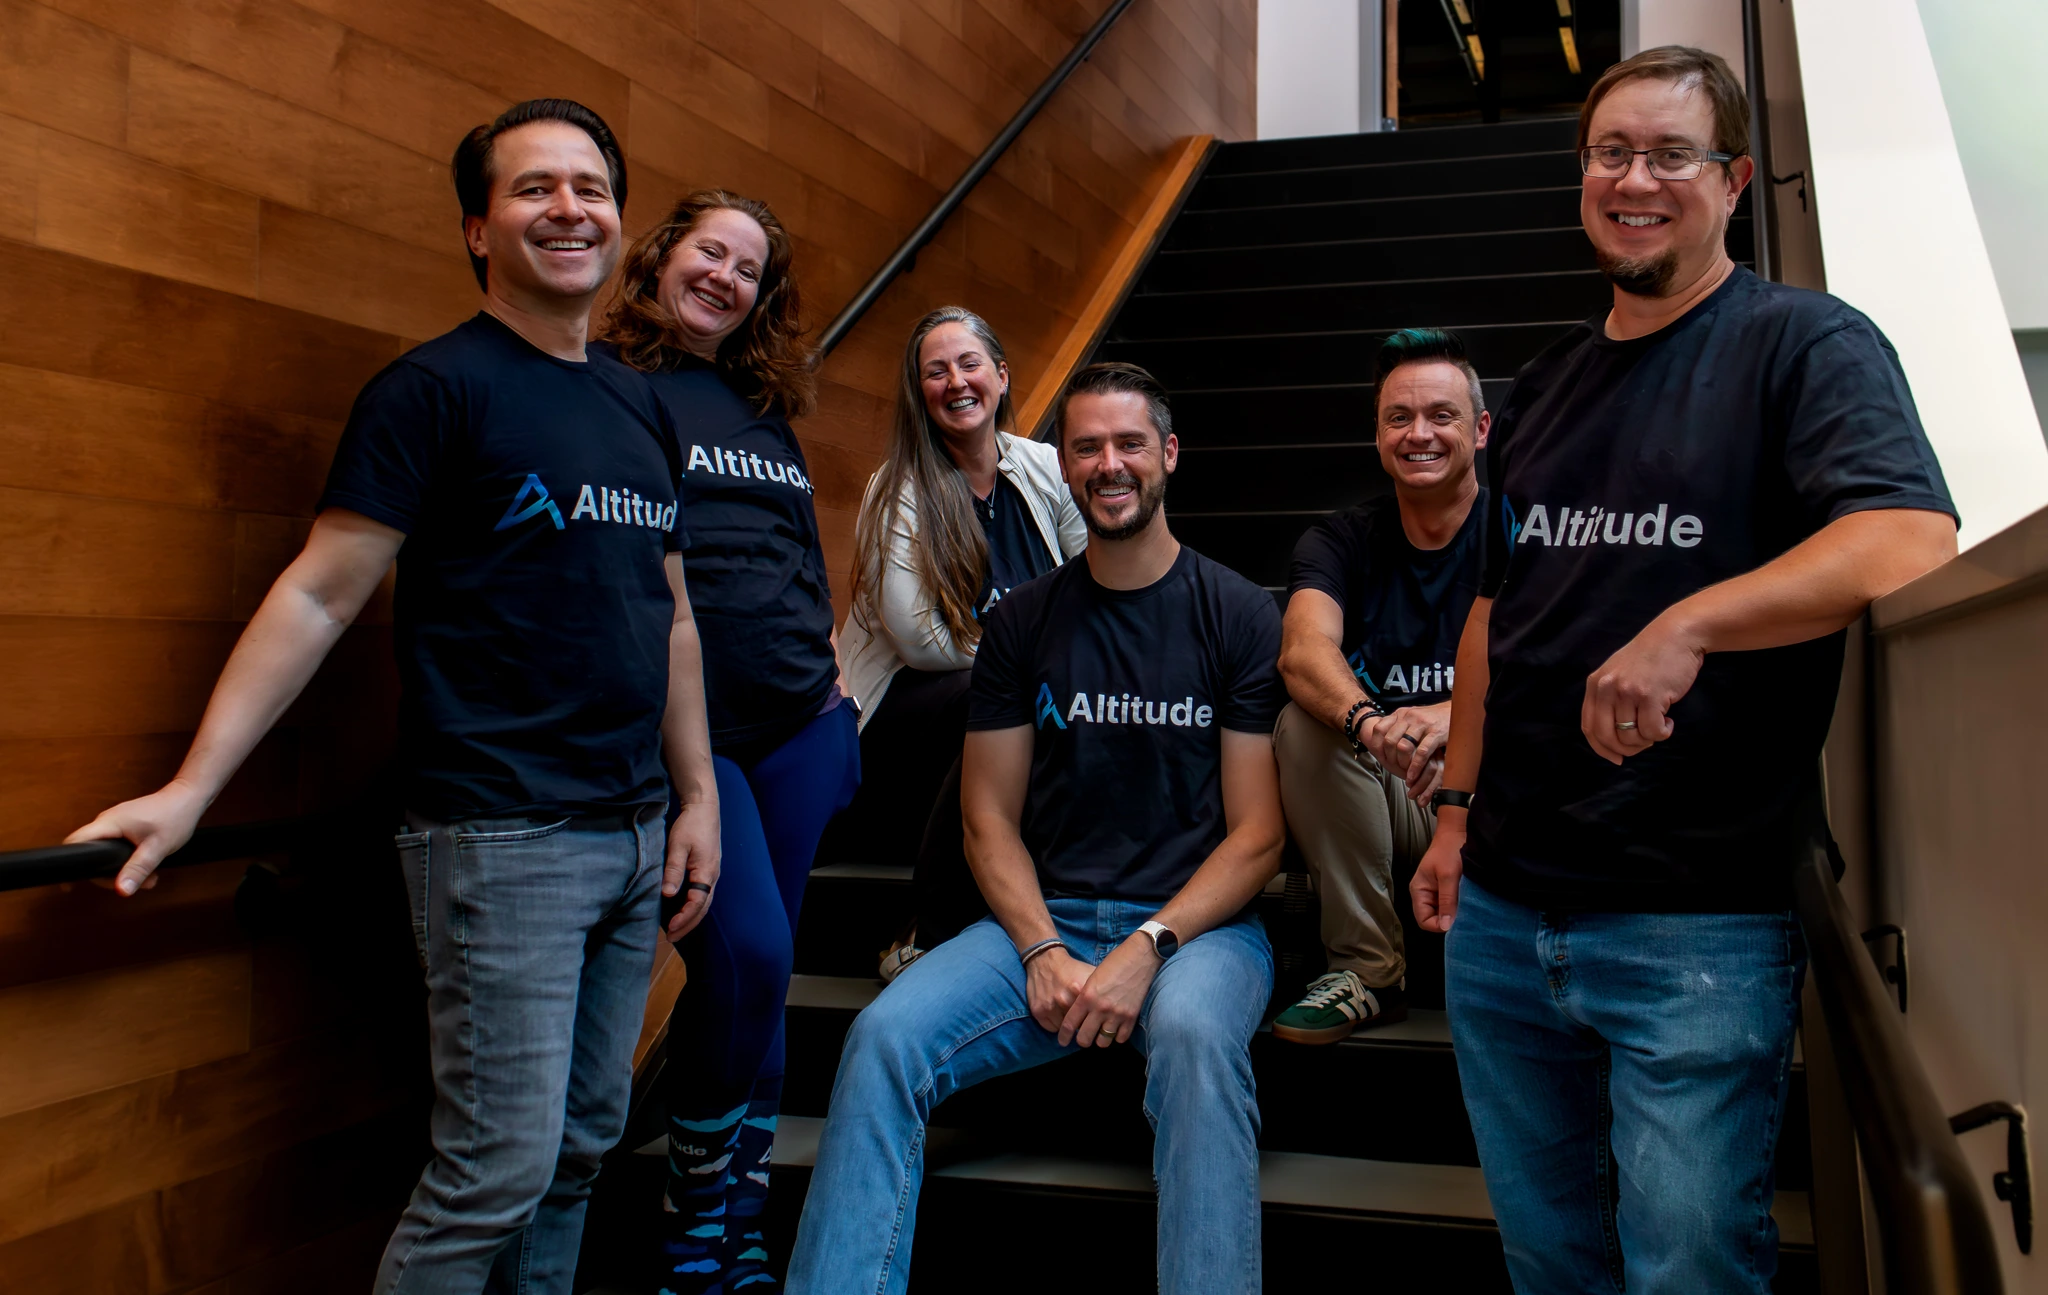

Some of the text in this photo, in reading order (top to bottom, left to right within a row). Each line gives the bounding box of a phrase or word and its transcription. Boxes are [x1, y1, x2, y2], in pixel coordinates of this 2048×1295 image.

[569, 483, 678, 533] Altitud
[1516, 503, 1704, 548] Altitude
[1066, 692, 1213, 728] Altitude
